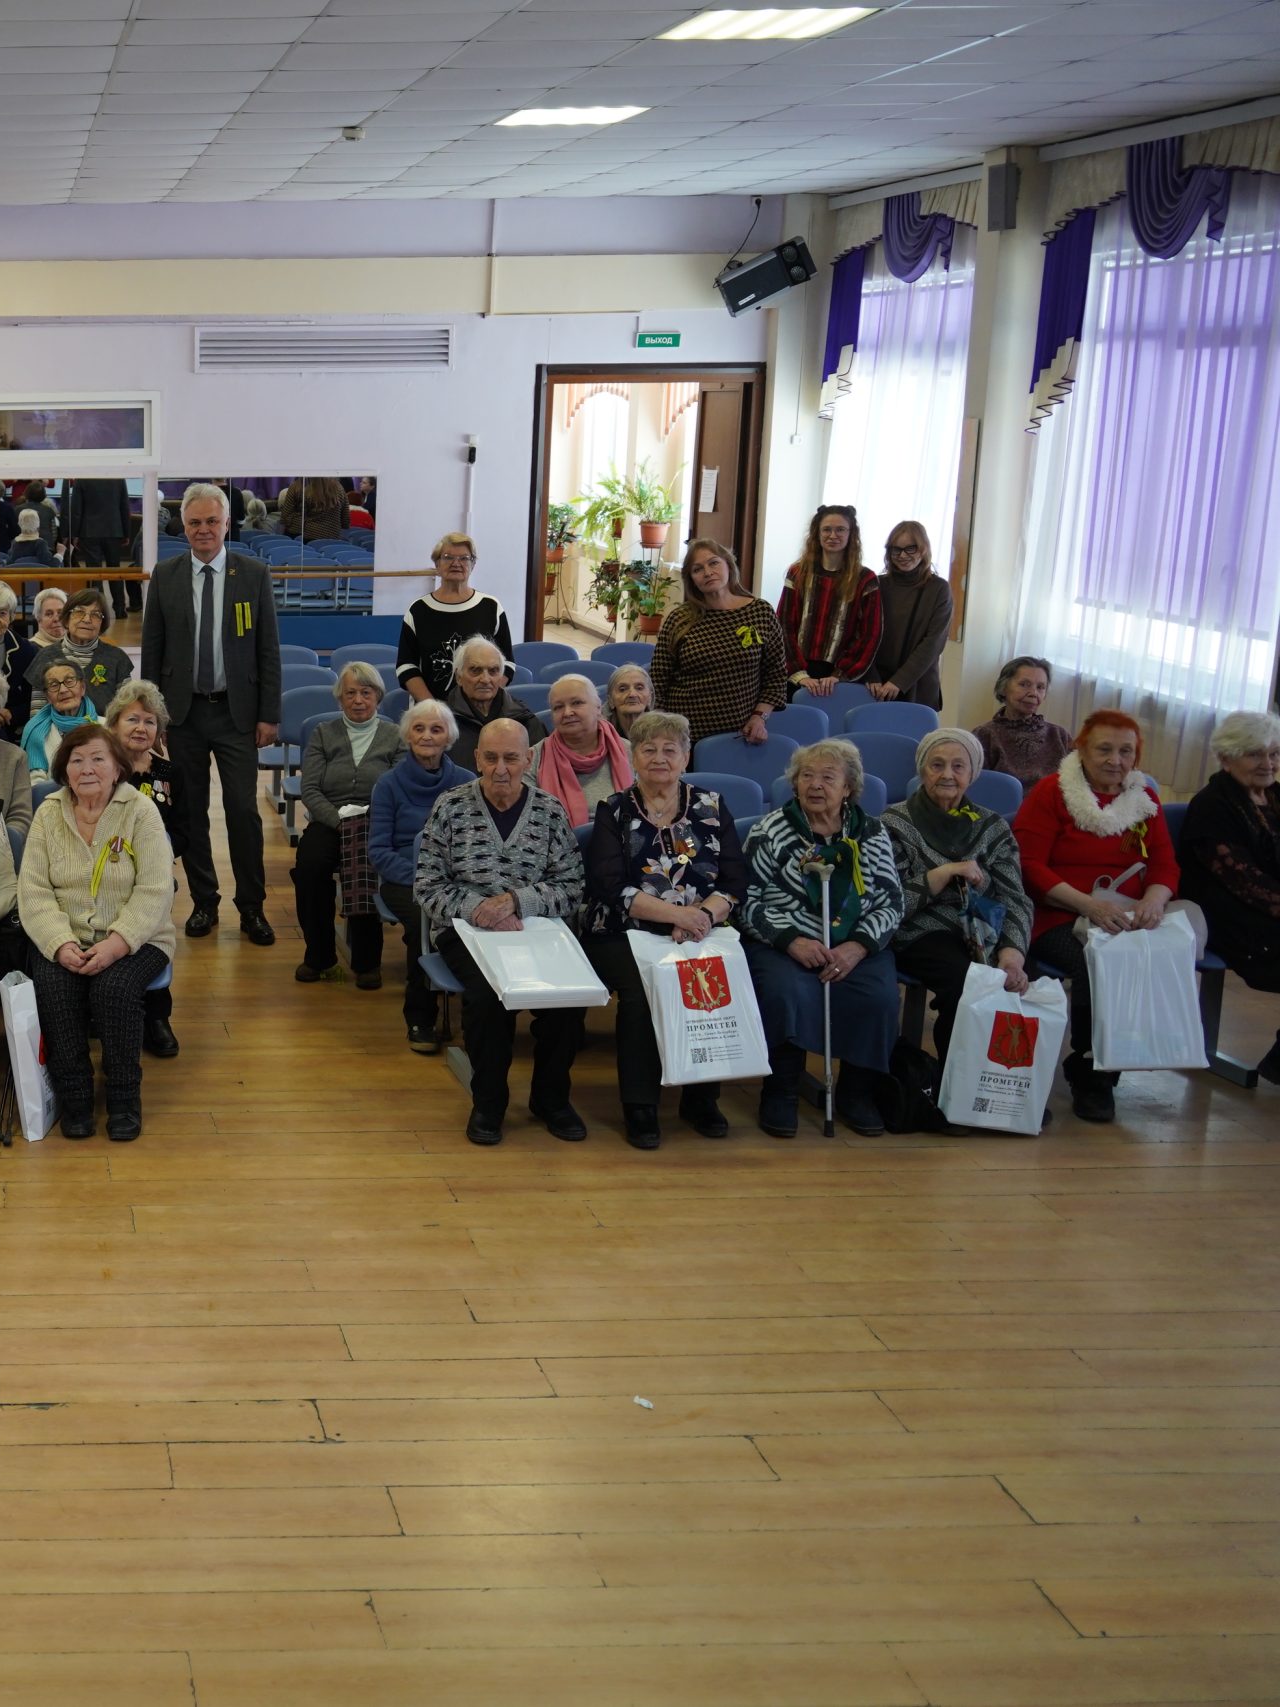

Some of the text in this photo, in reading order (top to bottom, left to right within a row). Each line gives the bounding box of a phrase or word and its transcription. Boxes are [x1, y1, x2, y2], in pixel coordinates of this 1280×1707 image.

[644, 336, 673, 345] ВЫХОД
[686, 1019, 738, 1032] ПРОМЕТЕЙ
[979, 1075, 1031, 1089] ПРОМЕТЕЙ
